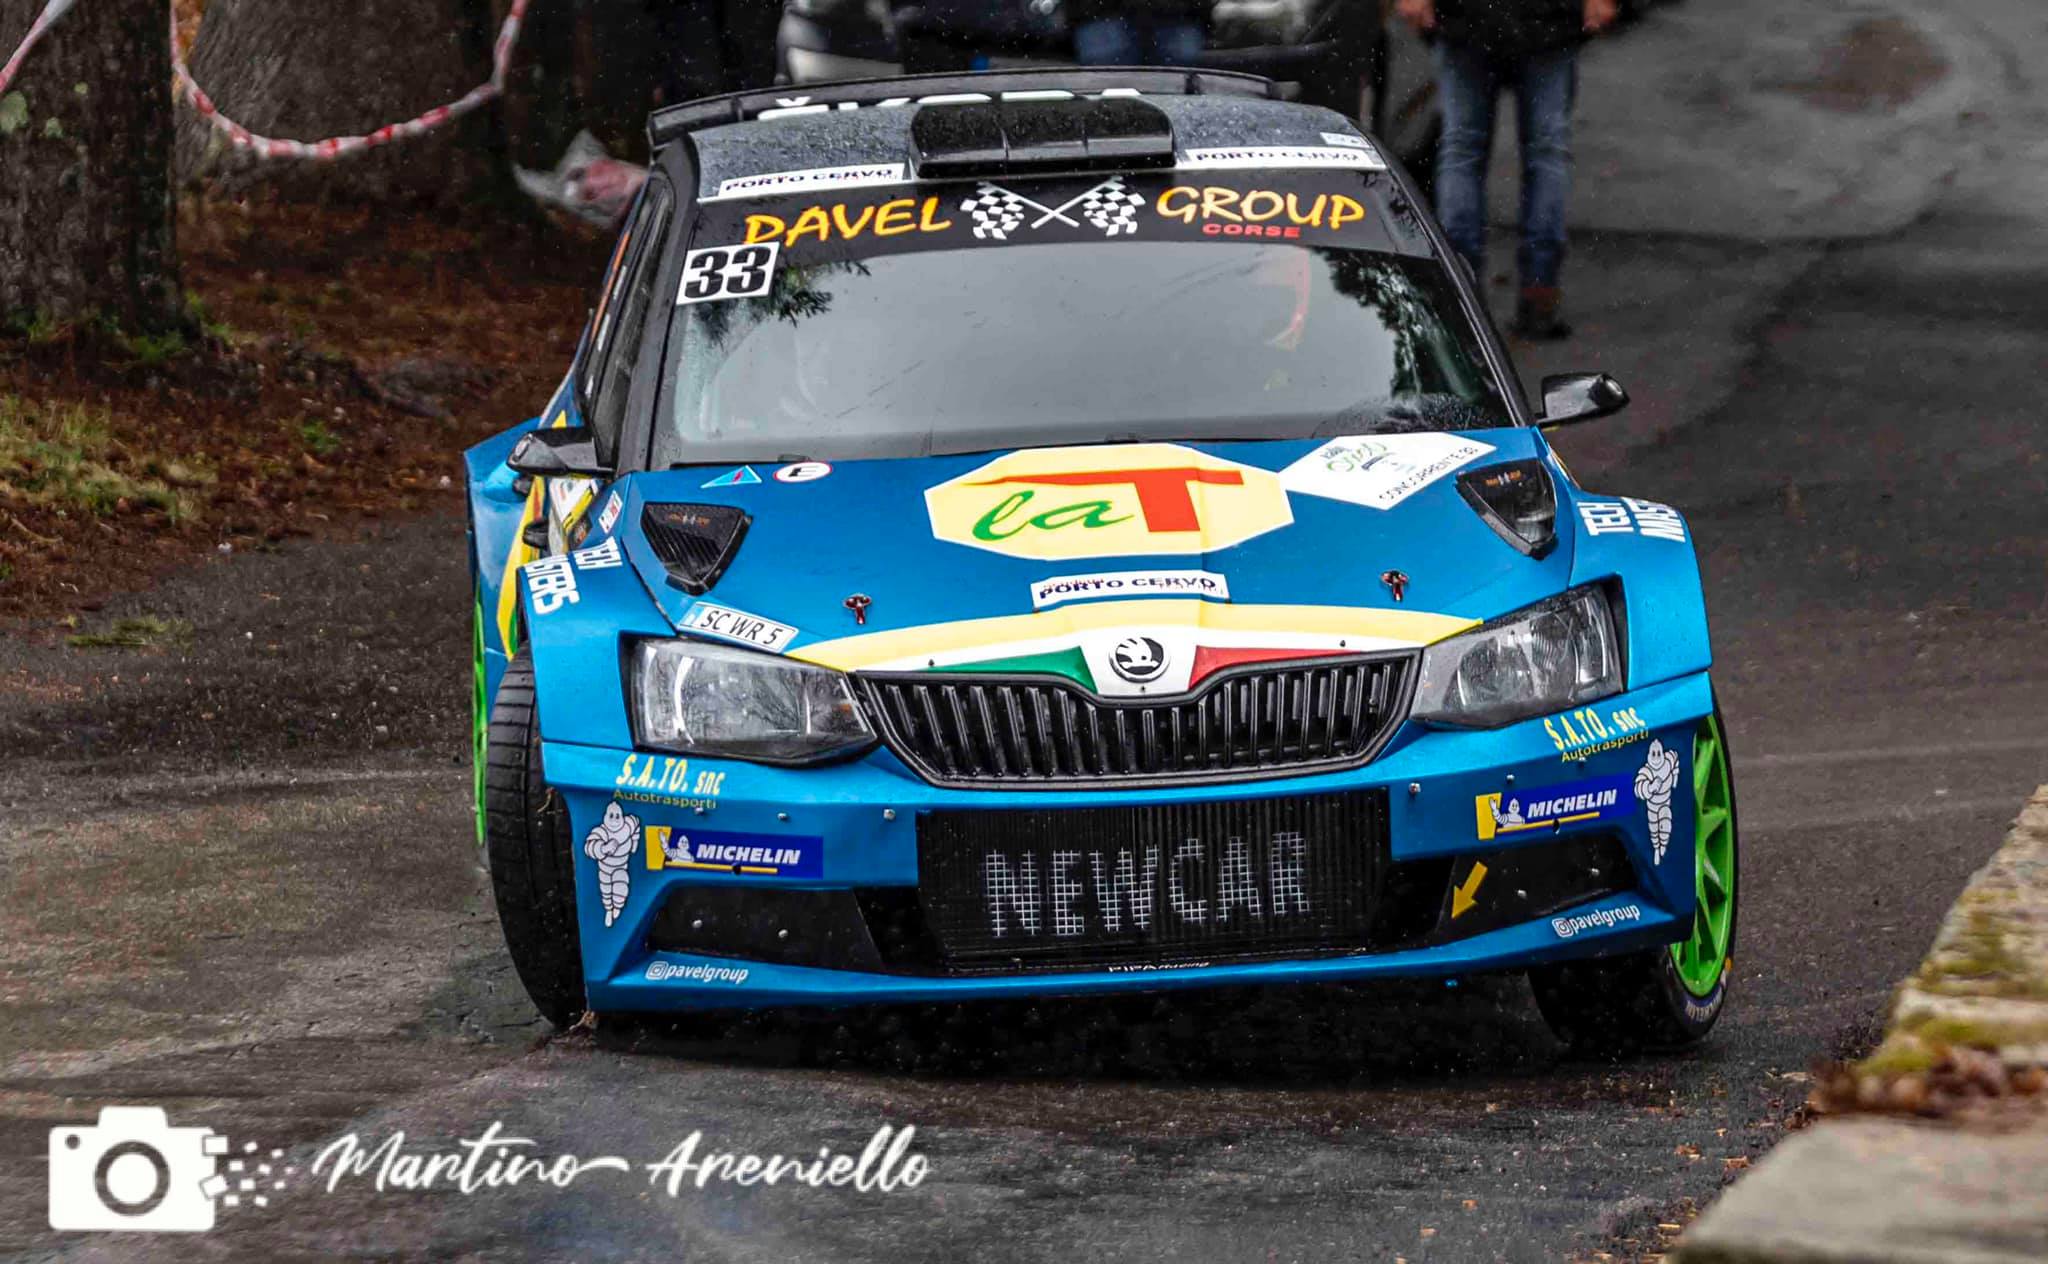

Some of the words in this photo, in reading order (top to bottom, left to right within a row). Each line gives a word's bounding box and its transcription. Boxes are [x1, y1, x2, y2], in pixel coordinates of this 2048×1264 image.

[1196, 151, 1274, 161] PORTO
[725, 174, 804, 191] PORTO
[813, 168, 893, 180] CERVO
[744, 197, 951, 247] PAVEL
[1157, 186, 1365, 230] GROUP
[1203, 223, 1300, 238] CORSE
[684, 247, 771, 299] 33
[1577, 502, 1634, 536] TECH
[1039, 578, 1124, 600] PORTO
[1131, 577, 1217, 590] CERVO
[700, 610, 731, 631] SC
[729, 616, 765, 641] WR
[763, 627, 784, 646] 5
[1561, 728, 1649, 763] Autotrasporti
[613, 788, 717, 809] Autotrasporti
[1527, 788, 1617, 820] MICHELIN
[696, 843, 801, 865] MICHELIN
